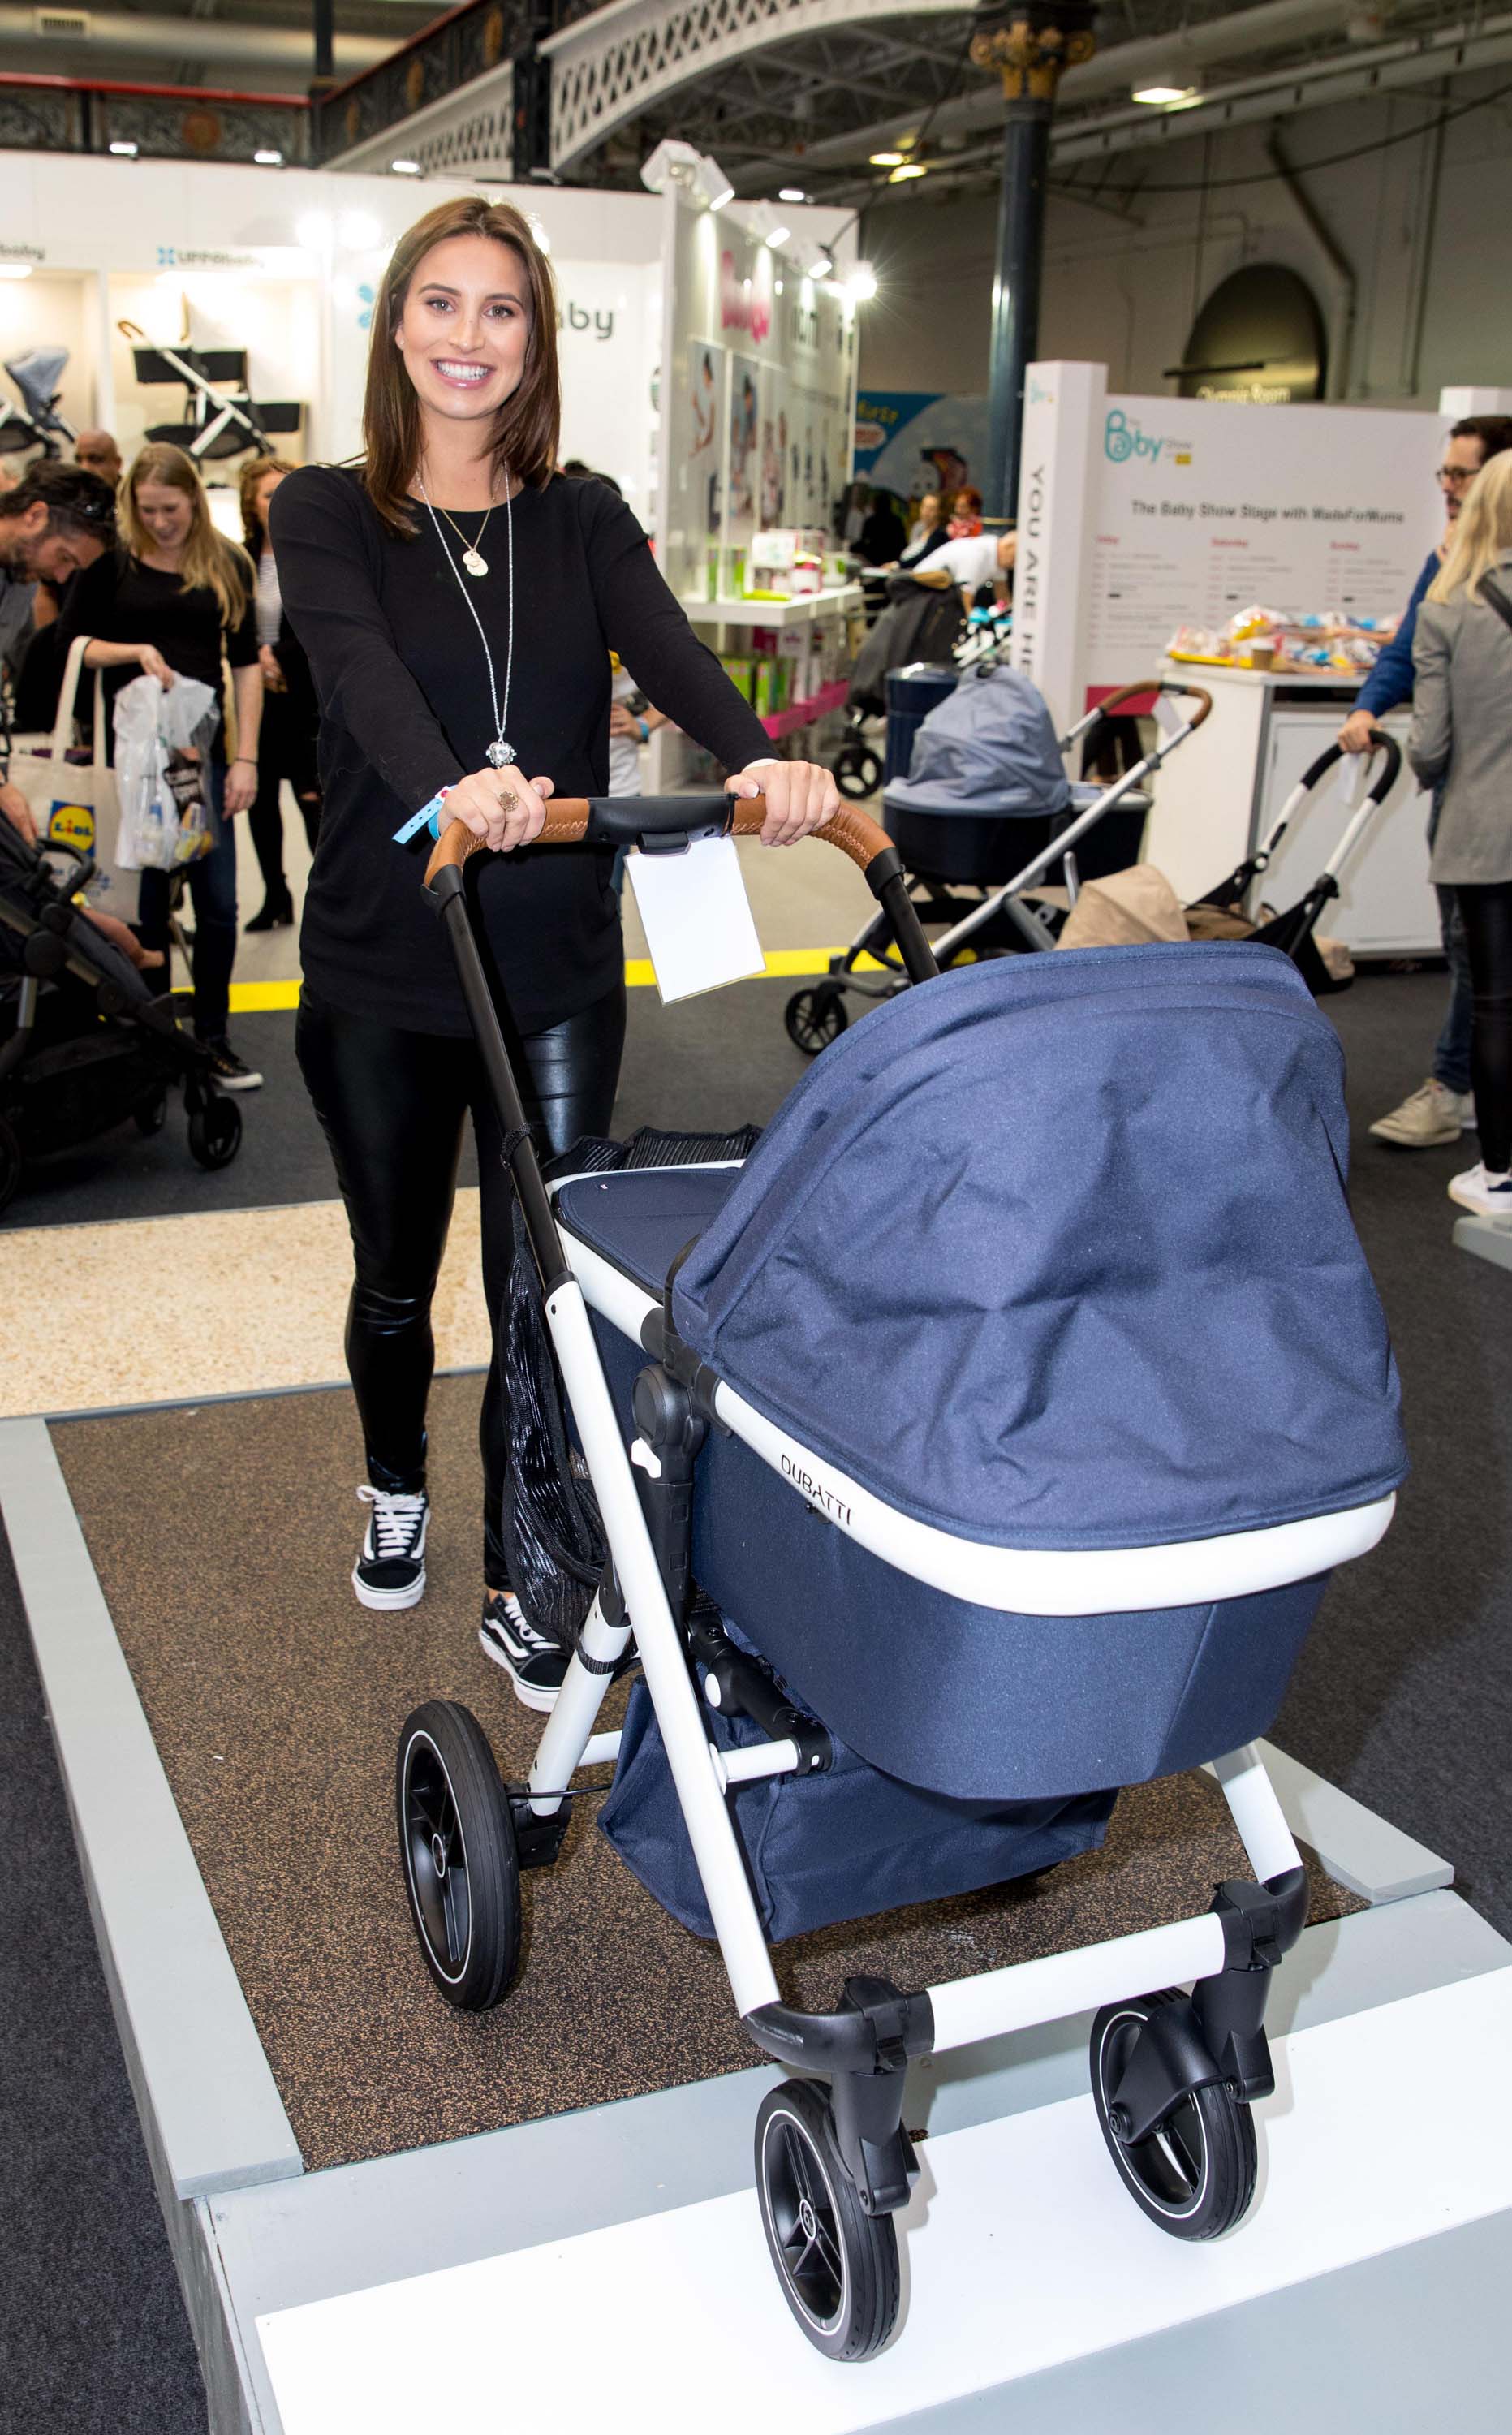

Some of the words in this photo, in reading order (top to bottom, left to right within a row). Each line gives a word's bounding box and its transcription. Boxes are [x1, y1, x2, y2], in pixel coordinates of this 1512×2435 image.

[554, 301, 614, 340] by
[1027, 465, 1045, 537] YOU
[1132, 500, 1156, 515] The
[1161, 502, 1195, 520] Baby
[1200, 502, 1236, 518] Show
[1240, 504, 1277, 523] Stage
[1282, 505, 1307, 520] with
[1312, 505, 1405, 524] MadeForMums
[1023, 549, 1039, 620] ARE
[781, 1454, 851, 1525] DUBATTI
